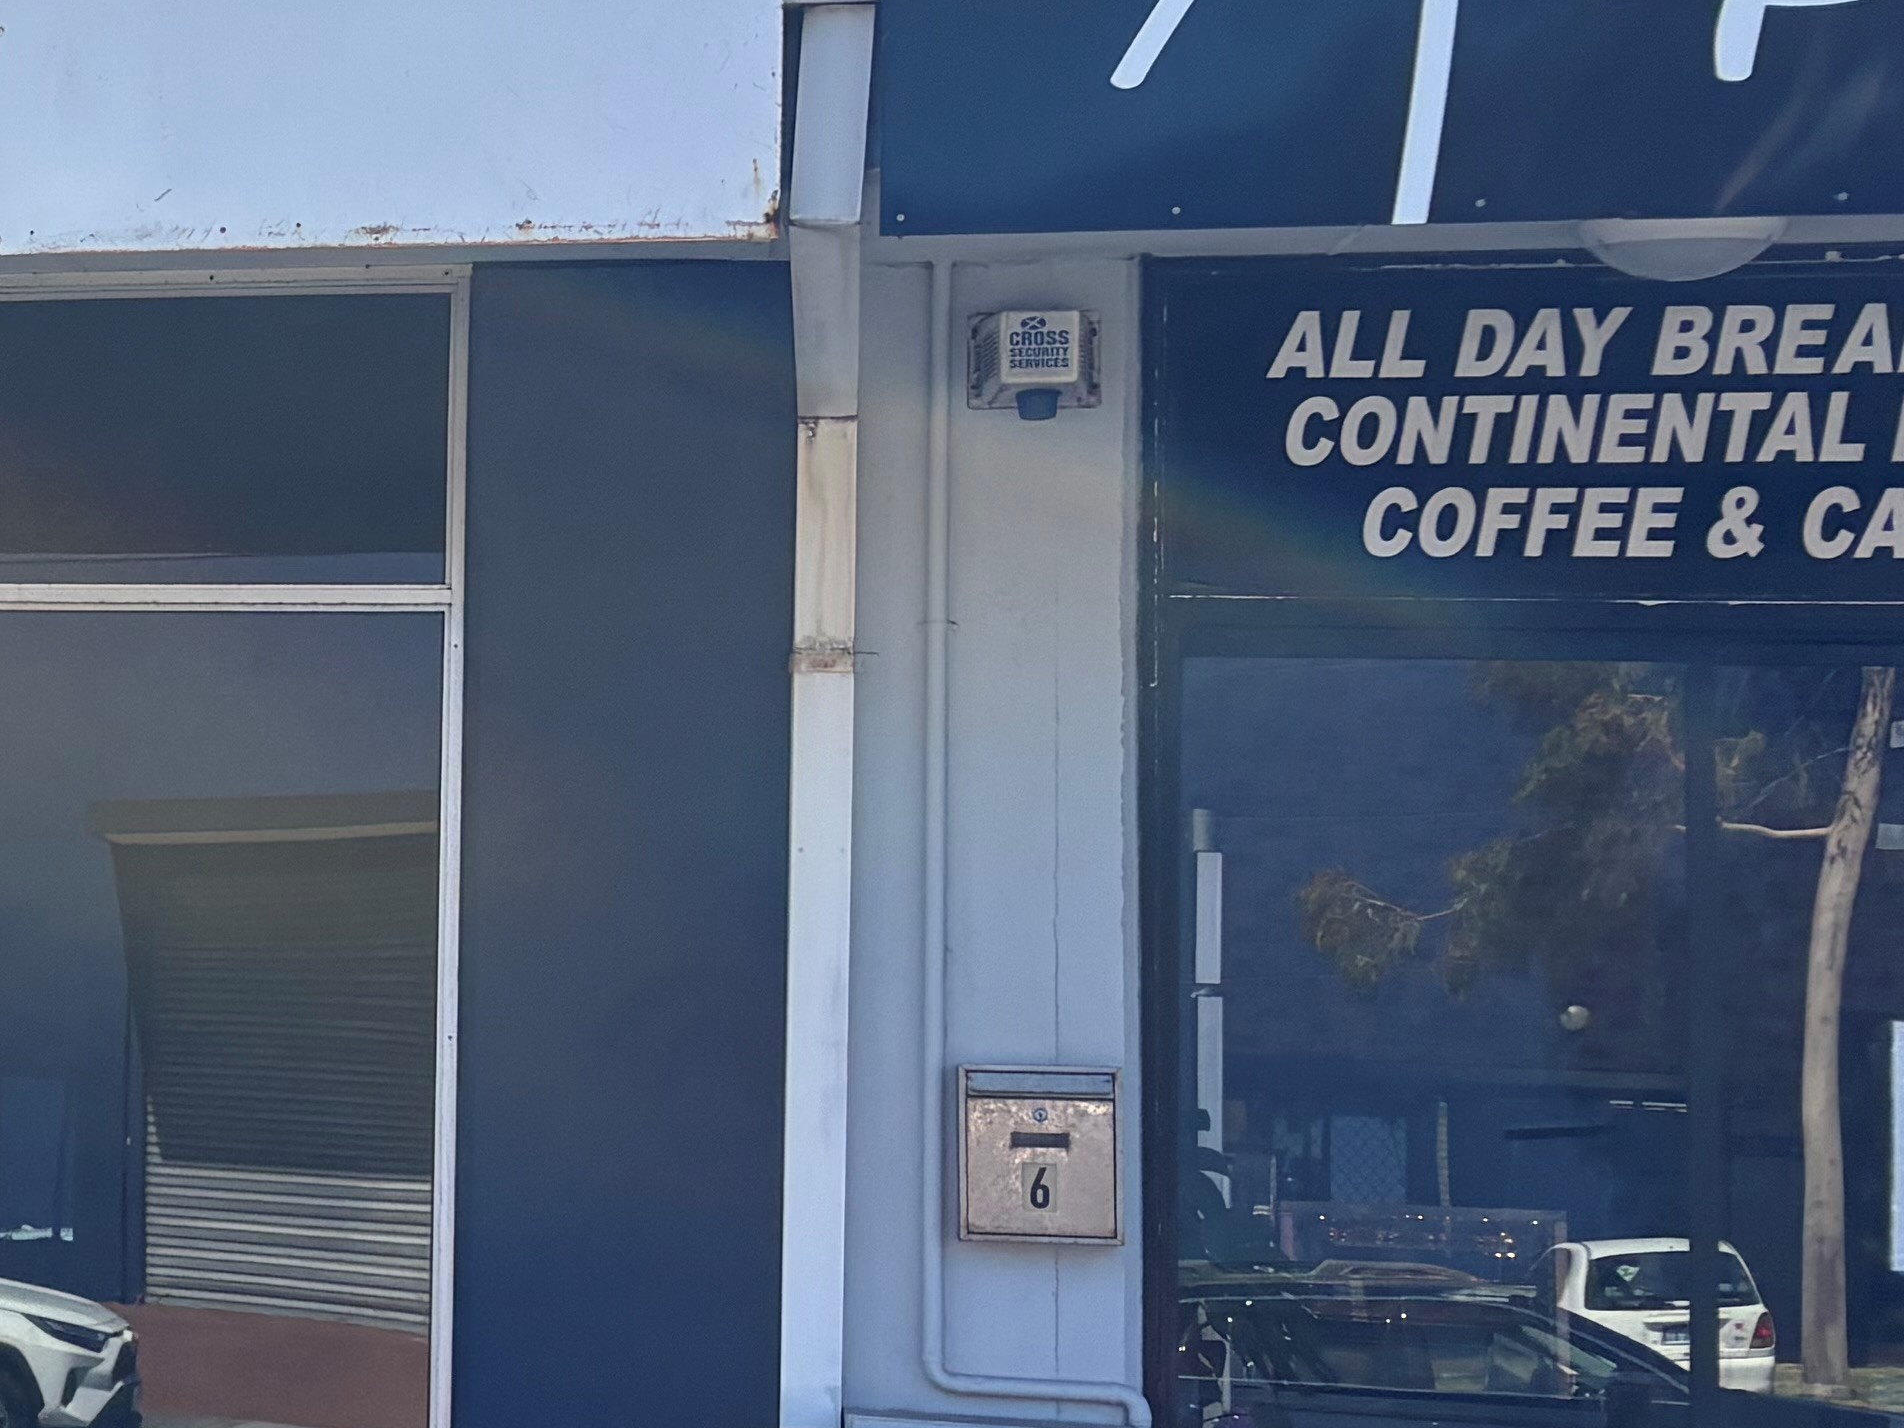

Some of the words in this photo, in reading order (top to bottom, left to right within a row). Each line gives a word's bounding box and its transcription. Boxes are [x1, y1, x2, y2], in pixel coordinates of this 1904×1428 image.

[1009, 330, 1070, 346] CROSS
[1009, 346, 1070, 358] SECURITY
[1265, 307, 1436, 379] ALL
[1453, 304, 1633, 378] DAY
[1654, 302, 1904, 376] BREA
[1009, 357, 1070, 369] SERVICES
[1284, 391, 1866, 466] CONTINENTAL
[1362, 486, 1684, 559] COFFEE
[1705, 486, 1766, 559] &
[1029, 1166, 1050, 1209] 6
